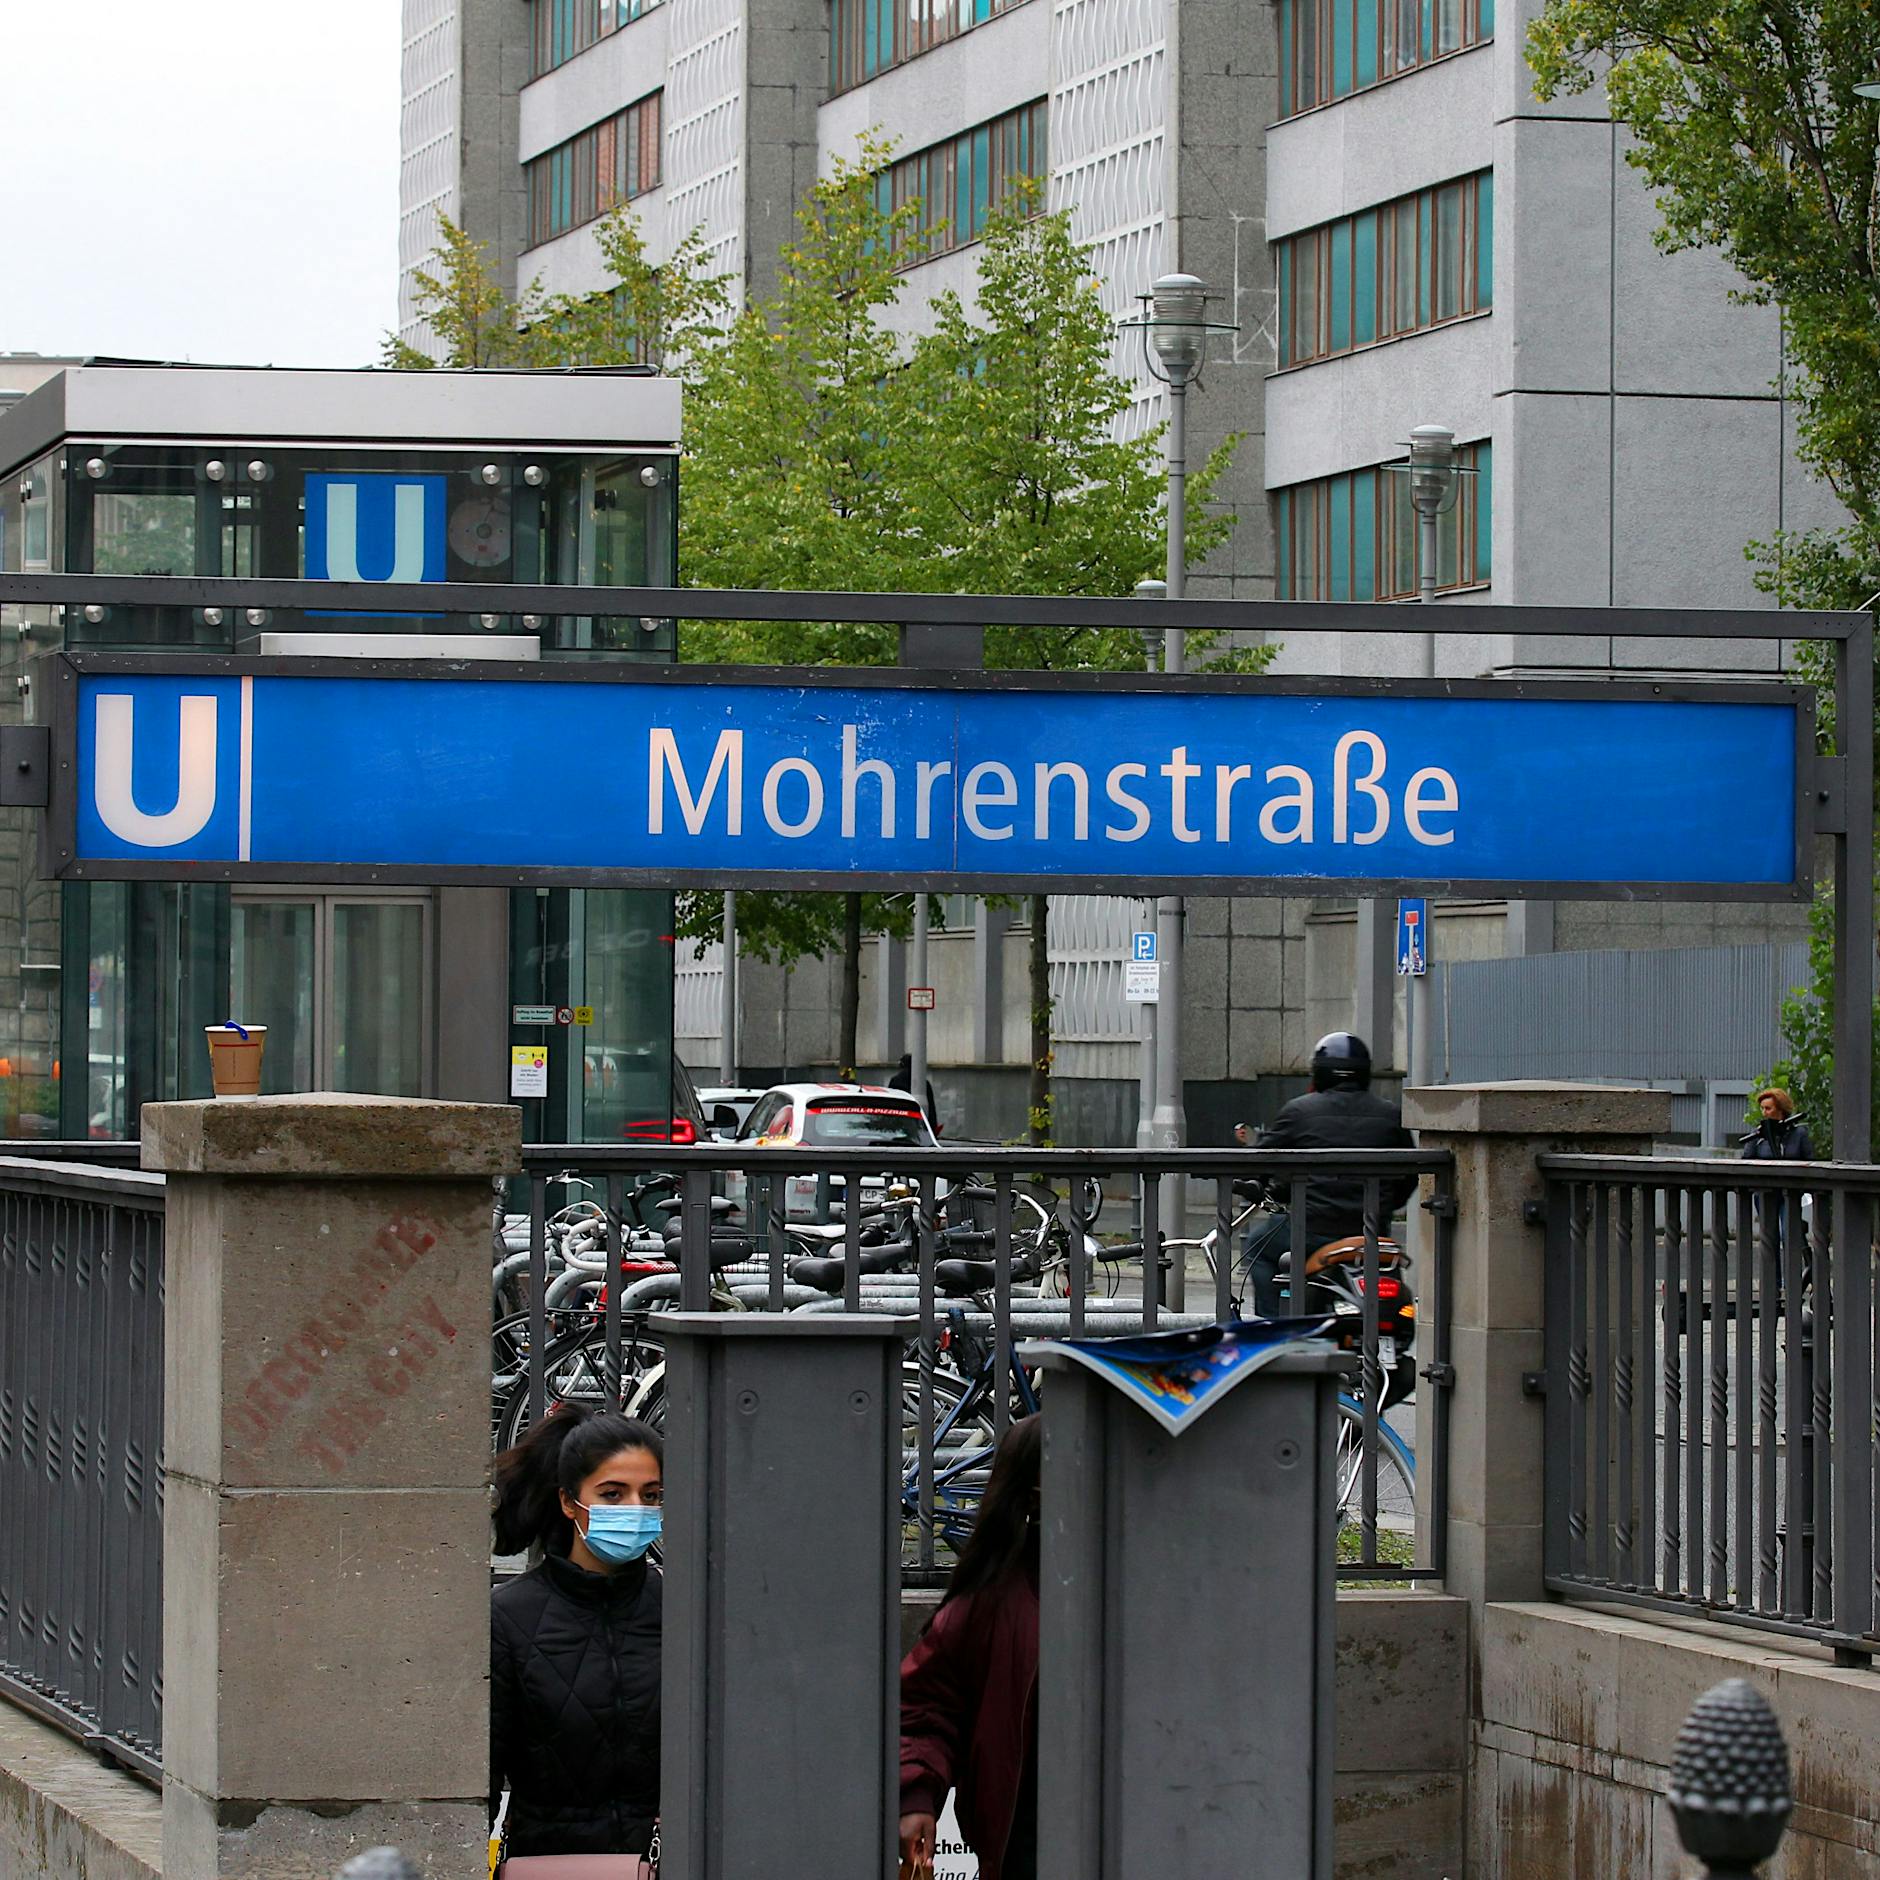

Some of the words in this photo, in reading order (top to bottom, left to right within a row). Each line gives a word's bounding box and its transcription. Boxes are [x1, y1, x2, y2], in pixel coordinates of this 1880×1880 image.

[326, 483, 425, 583] U
[94, 694, 218, 847] U
[647, 723, 1459, 847] Mohrenstraße
[1138, 935, 1151, 958] P
